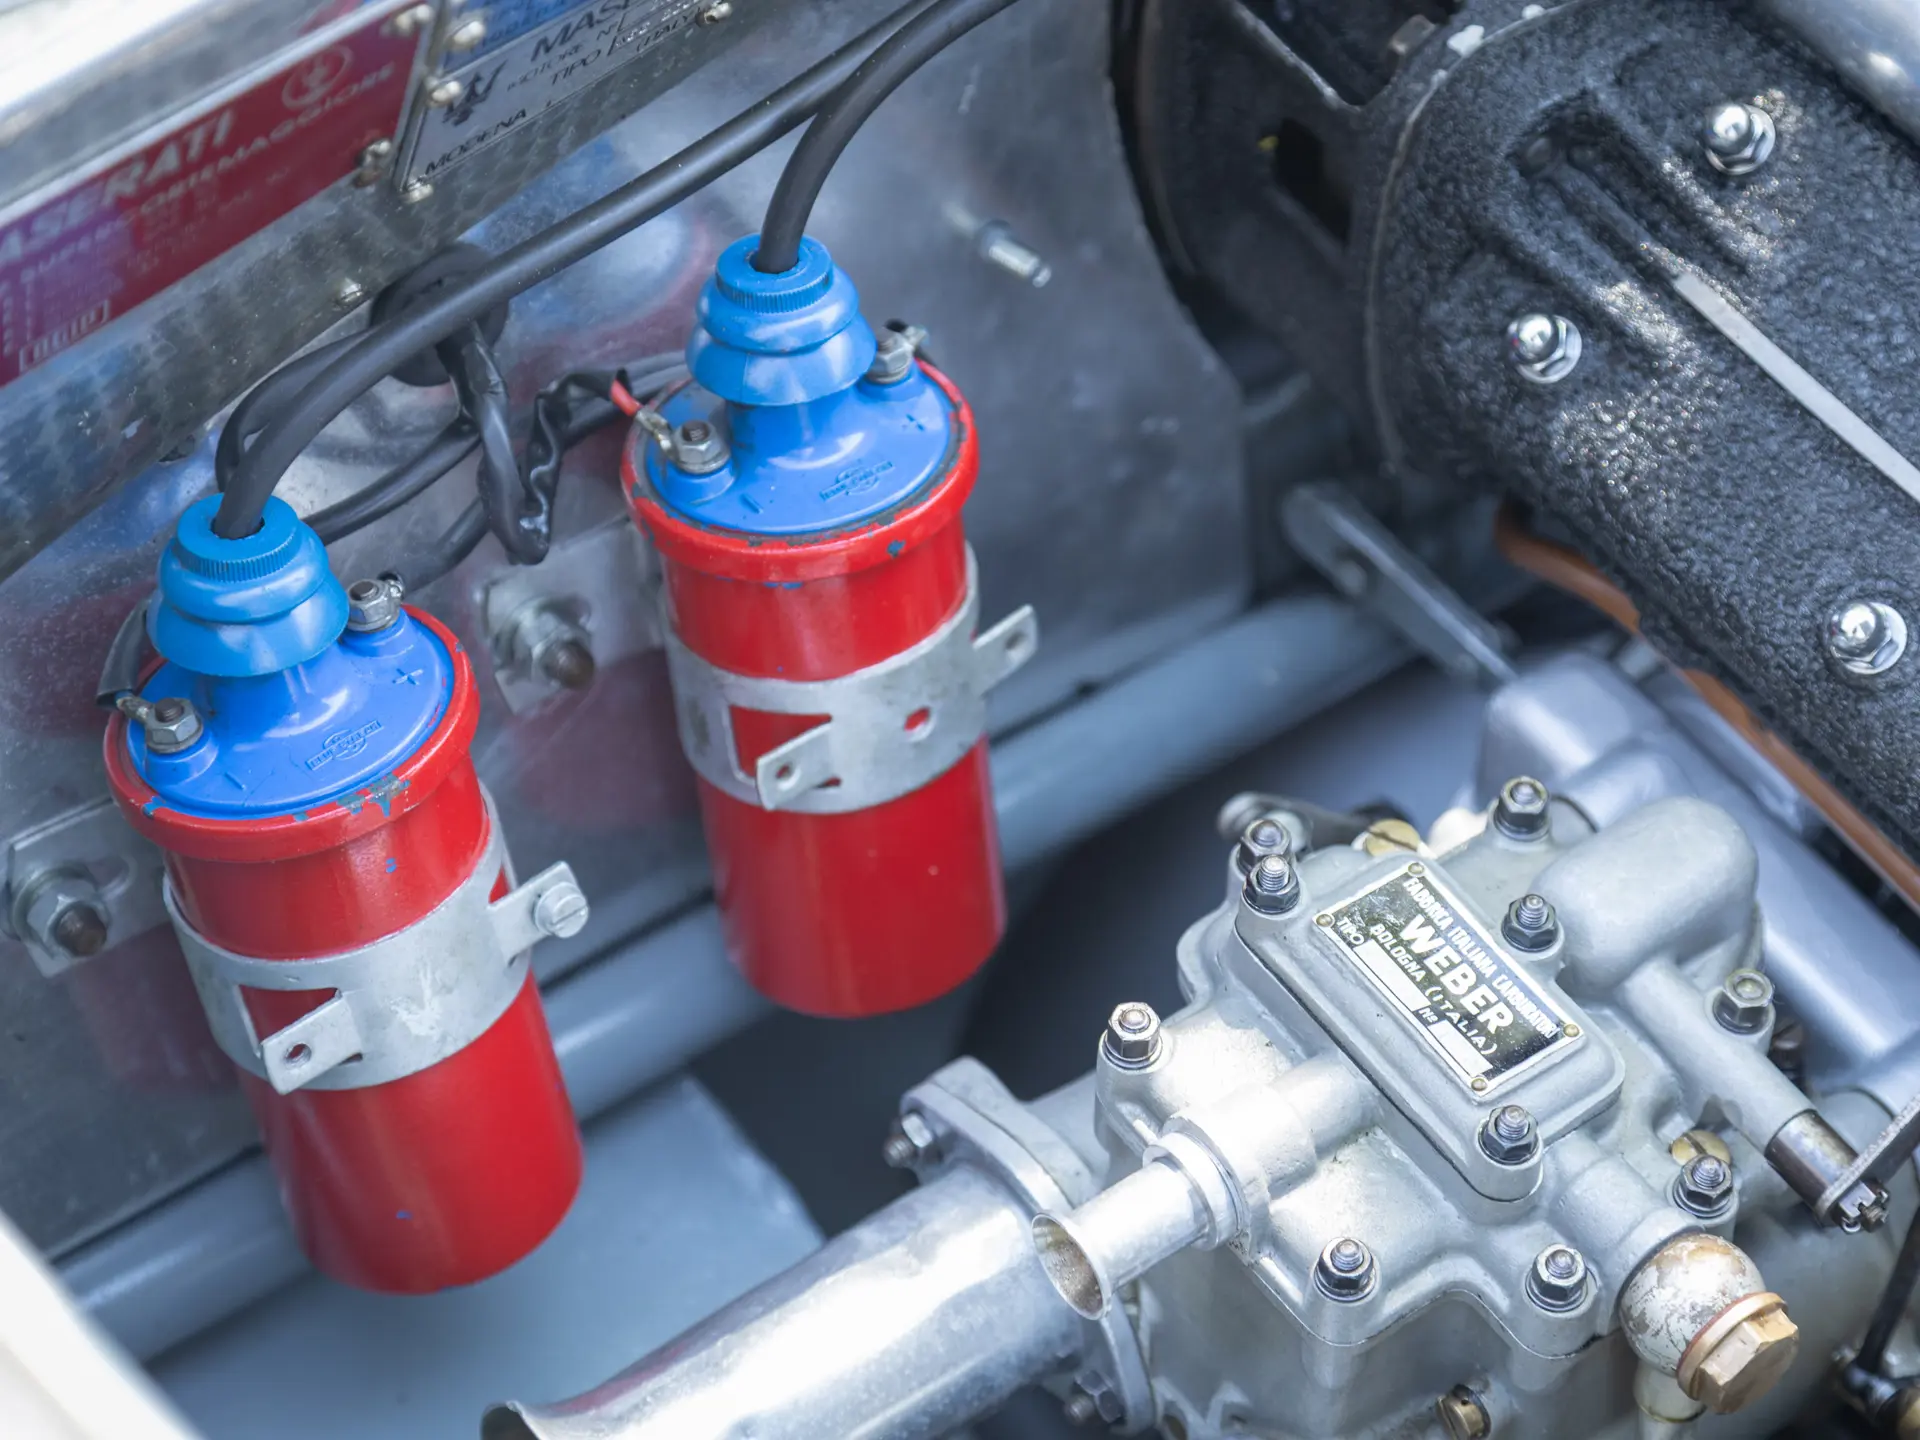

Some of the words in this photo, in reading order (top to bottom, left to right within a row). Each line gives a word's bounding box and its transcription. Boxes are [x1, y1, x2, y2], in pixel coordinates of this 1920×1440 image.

[425, 107, 528, 175] MODENA
[1336, 916, 1366, 945] TIPO
[1370, 923, 1428, 982] BOLOGNA
[1425, 986, 1498, 1055] (ITALIA)
[1400, 914, 1514, 1034] WEBER
[1403, 877, 1455, 930] FABBRICA
[1448, 926, 1498, 978] ITALIANA
[1492, 972, 1561, 1039] CARBURATORI
